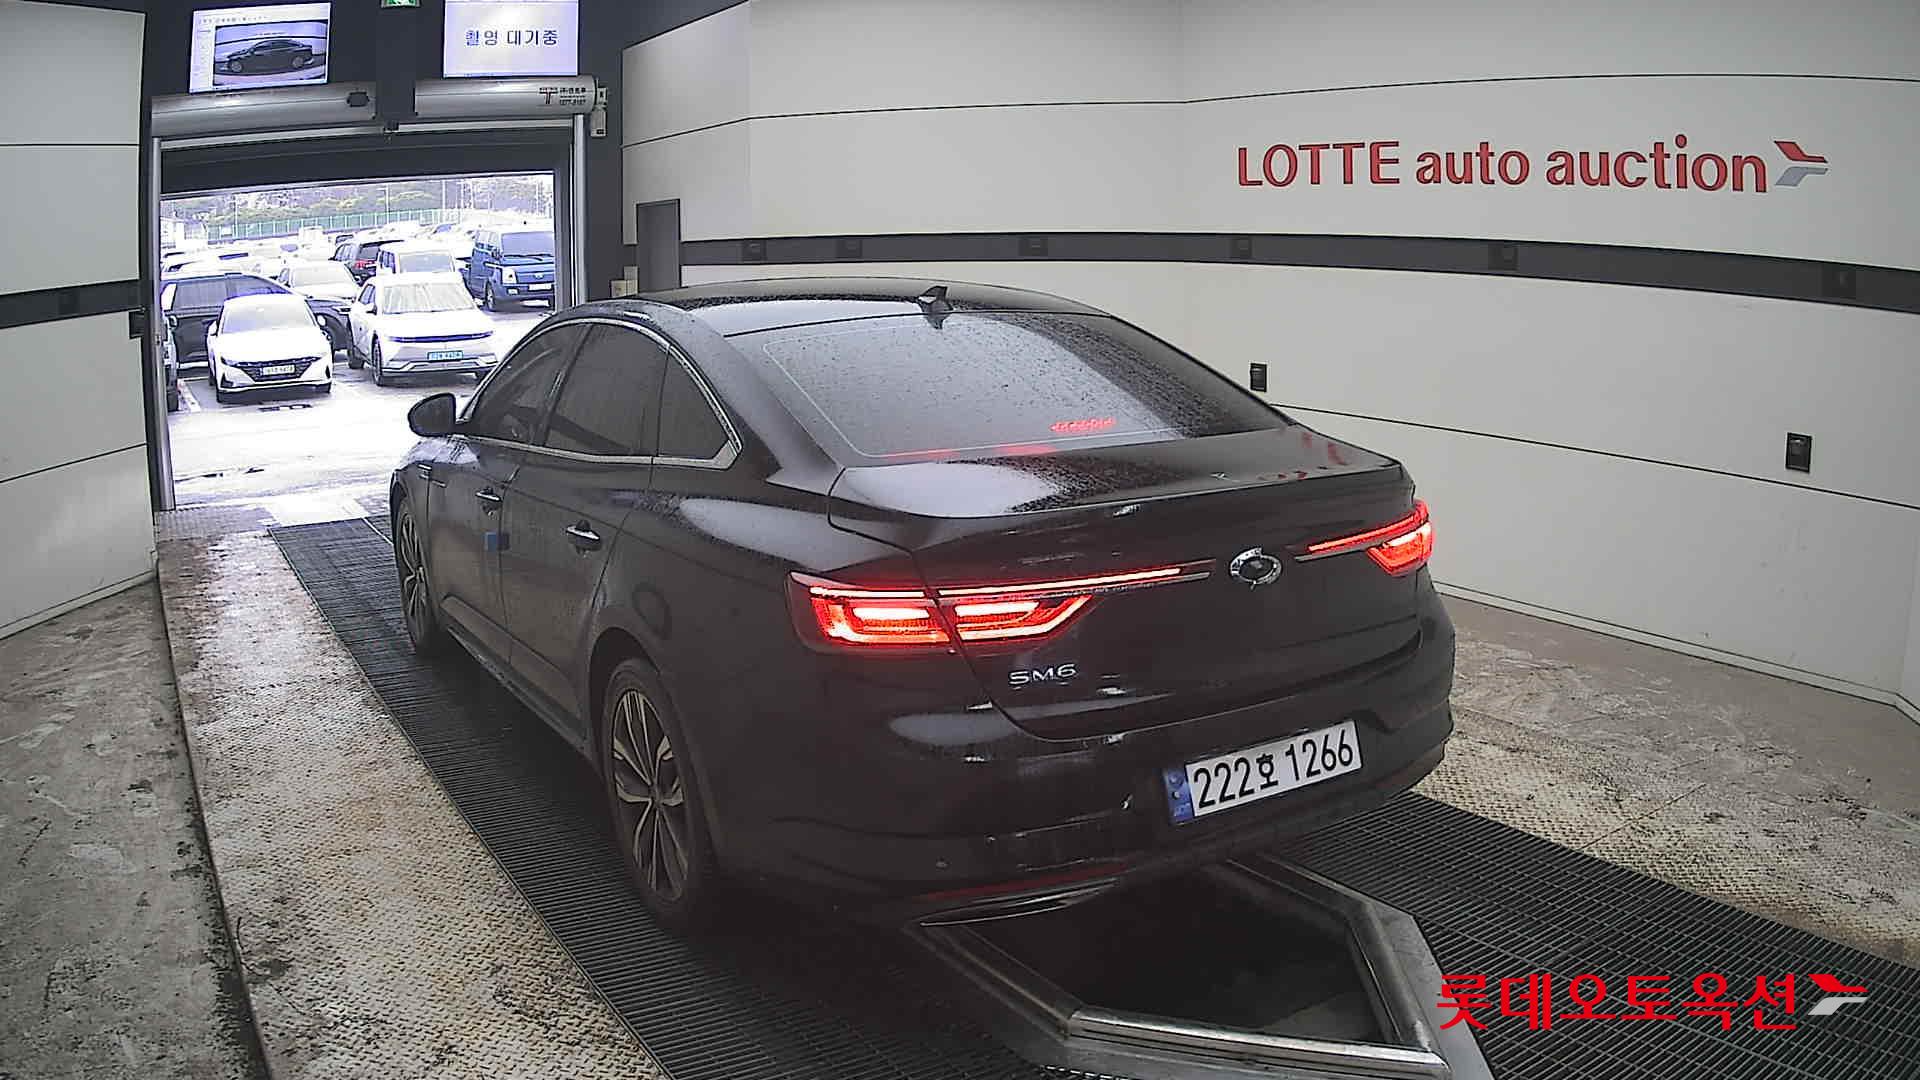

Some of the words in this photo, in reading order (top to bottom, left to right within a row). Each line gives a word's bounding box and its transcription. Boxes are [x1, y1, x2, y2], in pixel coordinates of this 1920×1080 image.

[507, 29, 558, 46] 대기중
[1238, 141, 1399, 187] LOTTE
[1417, 142, 1531, 185] auto
[1546, 133, 1767, 193] auction
[1009, 663, 1076, 685] SM6
[1194, 753, 1278, 809] 222호
[1285, 729, 1354, 781] 1266
